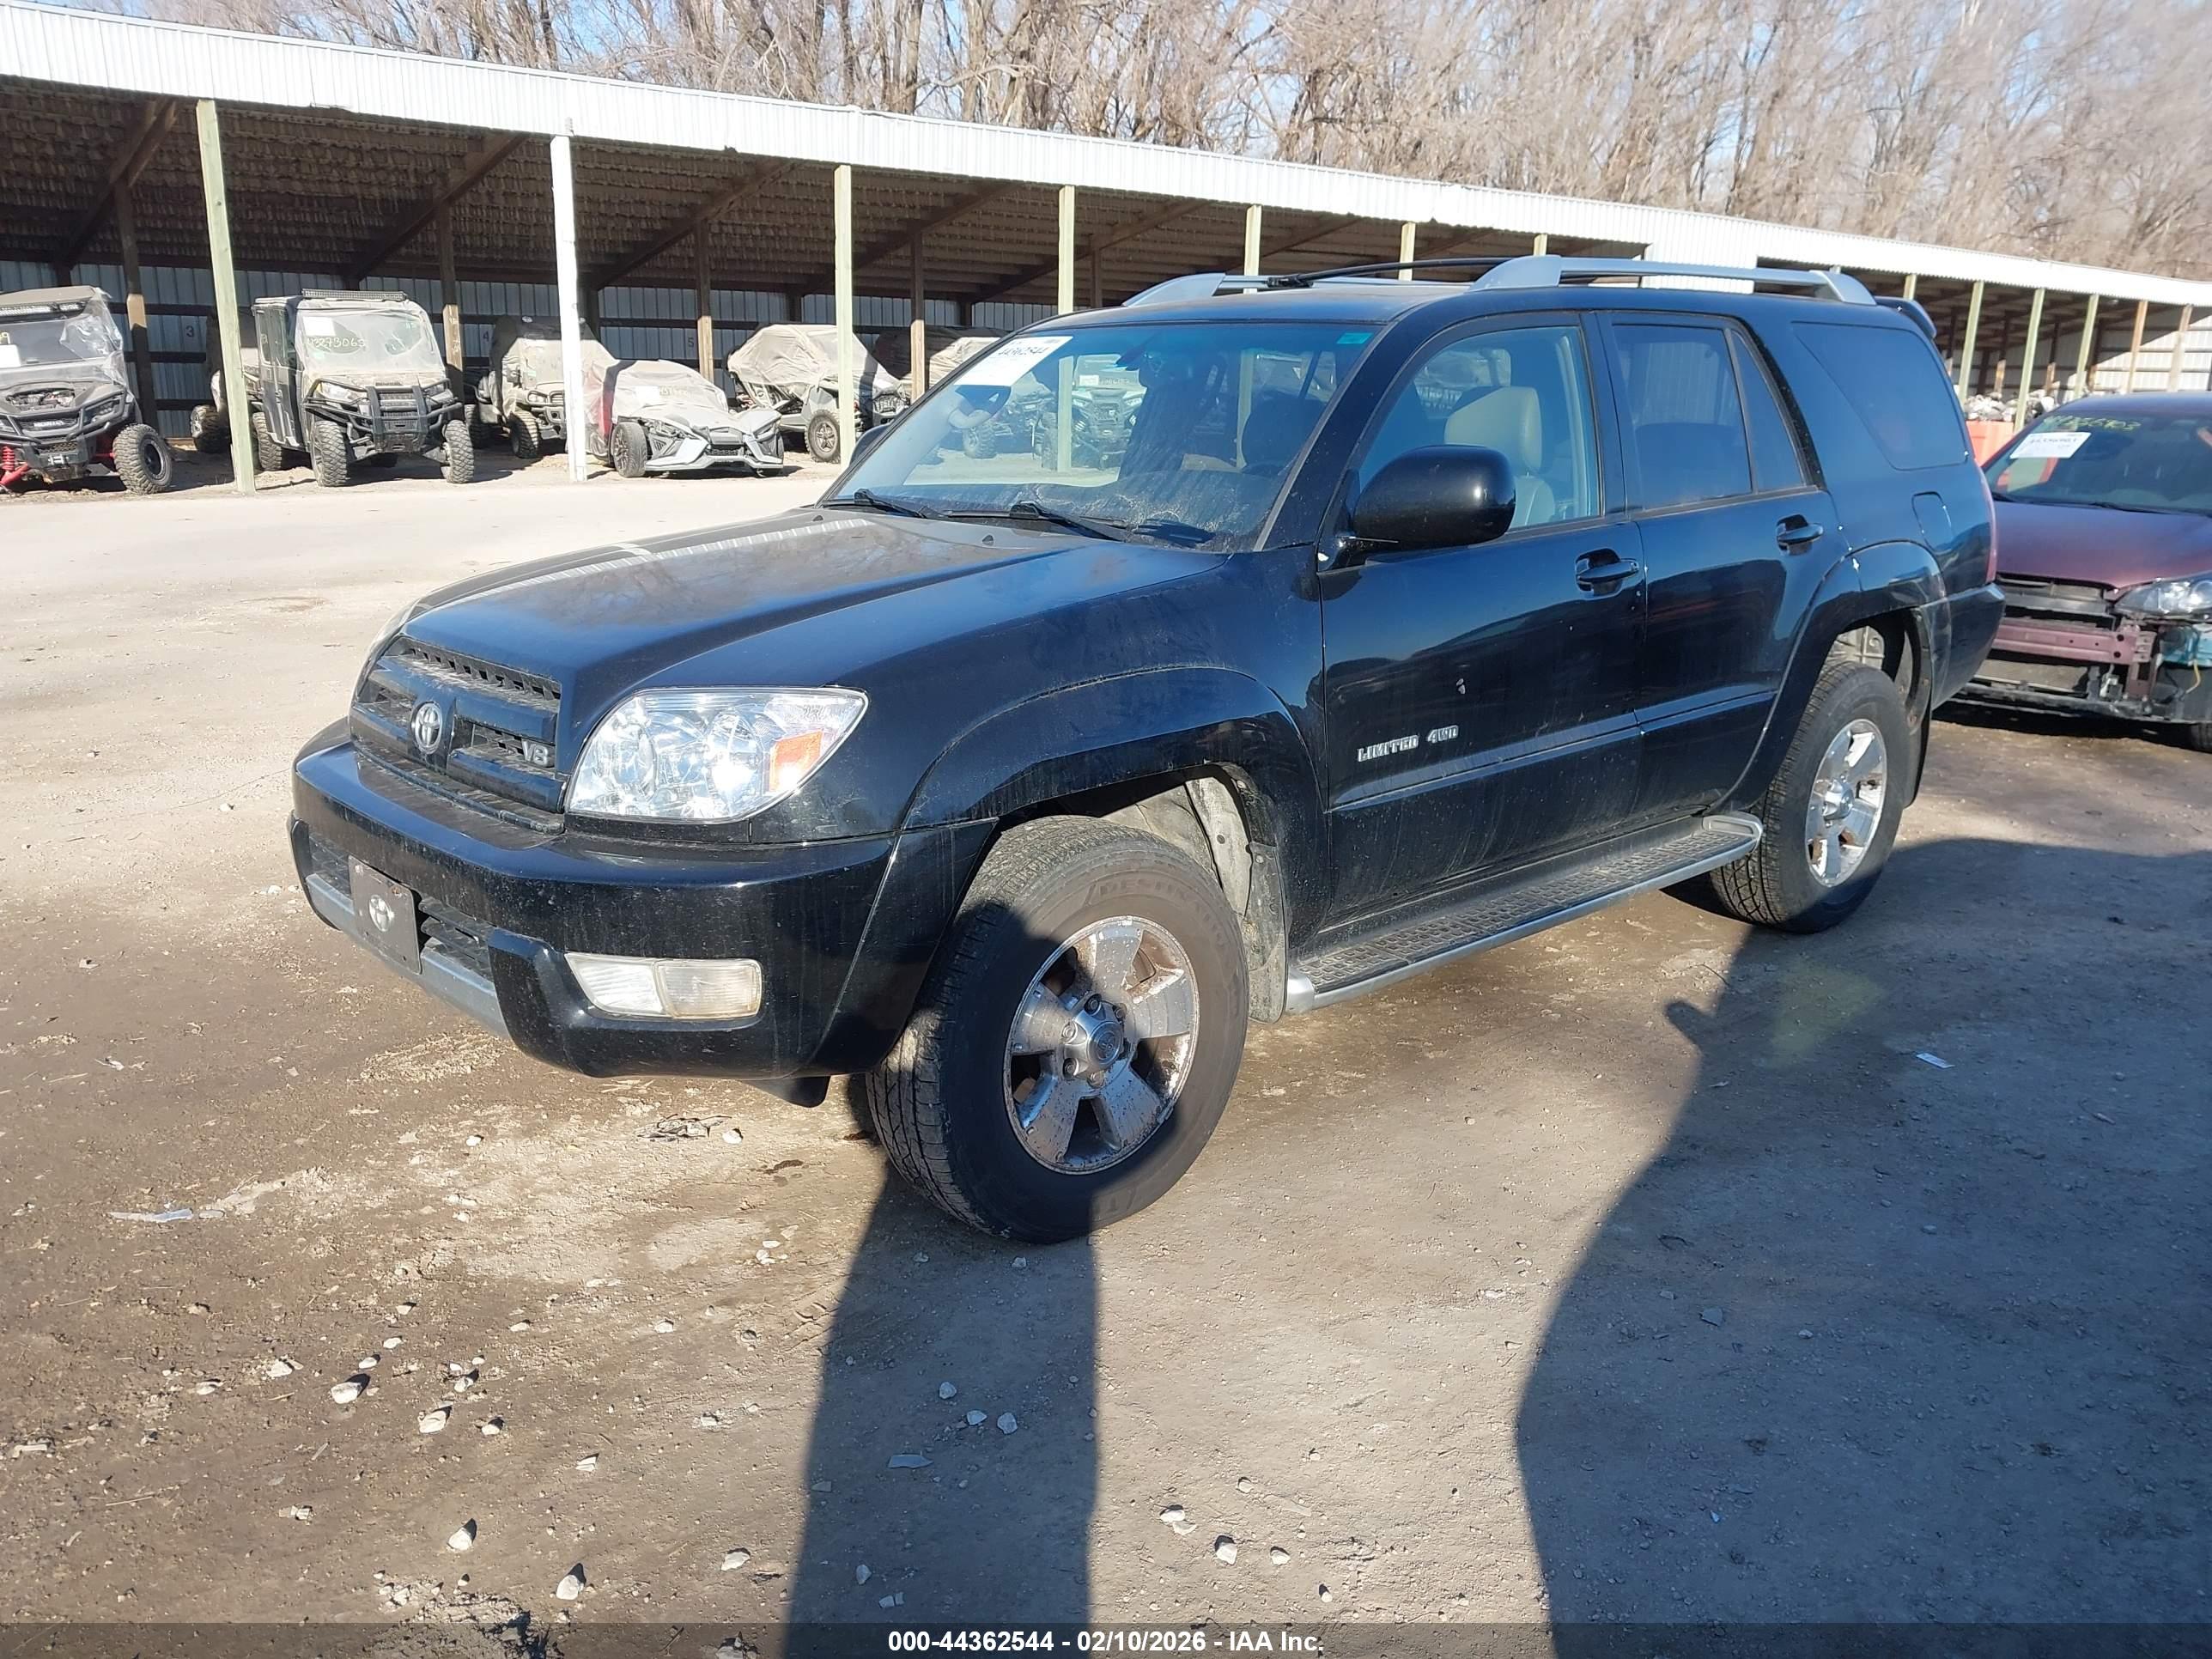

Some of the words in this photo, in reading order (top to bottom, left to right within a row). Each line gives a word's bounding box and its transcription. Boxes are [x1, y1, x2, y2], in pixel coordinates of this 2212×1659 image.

[185, 325, 194, 337] 3
[483, 331, 490, 343] 4
[687, 337, 695, 349] 5
[1357, 734, 1419, 763] LIMITED
[1426, 725, 1459, 744] 4WD
[521, 738, 549, 766] V8
